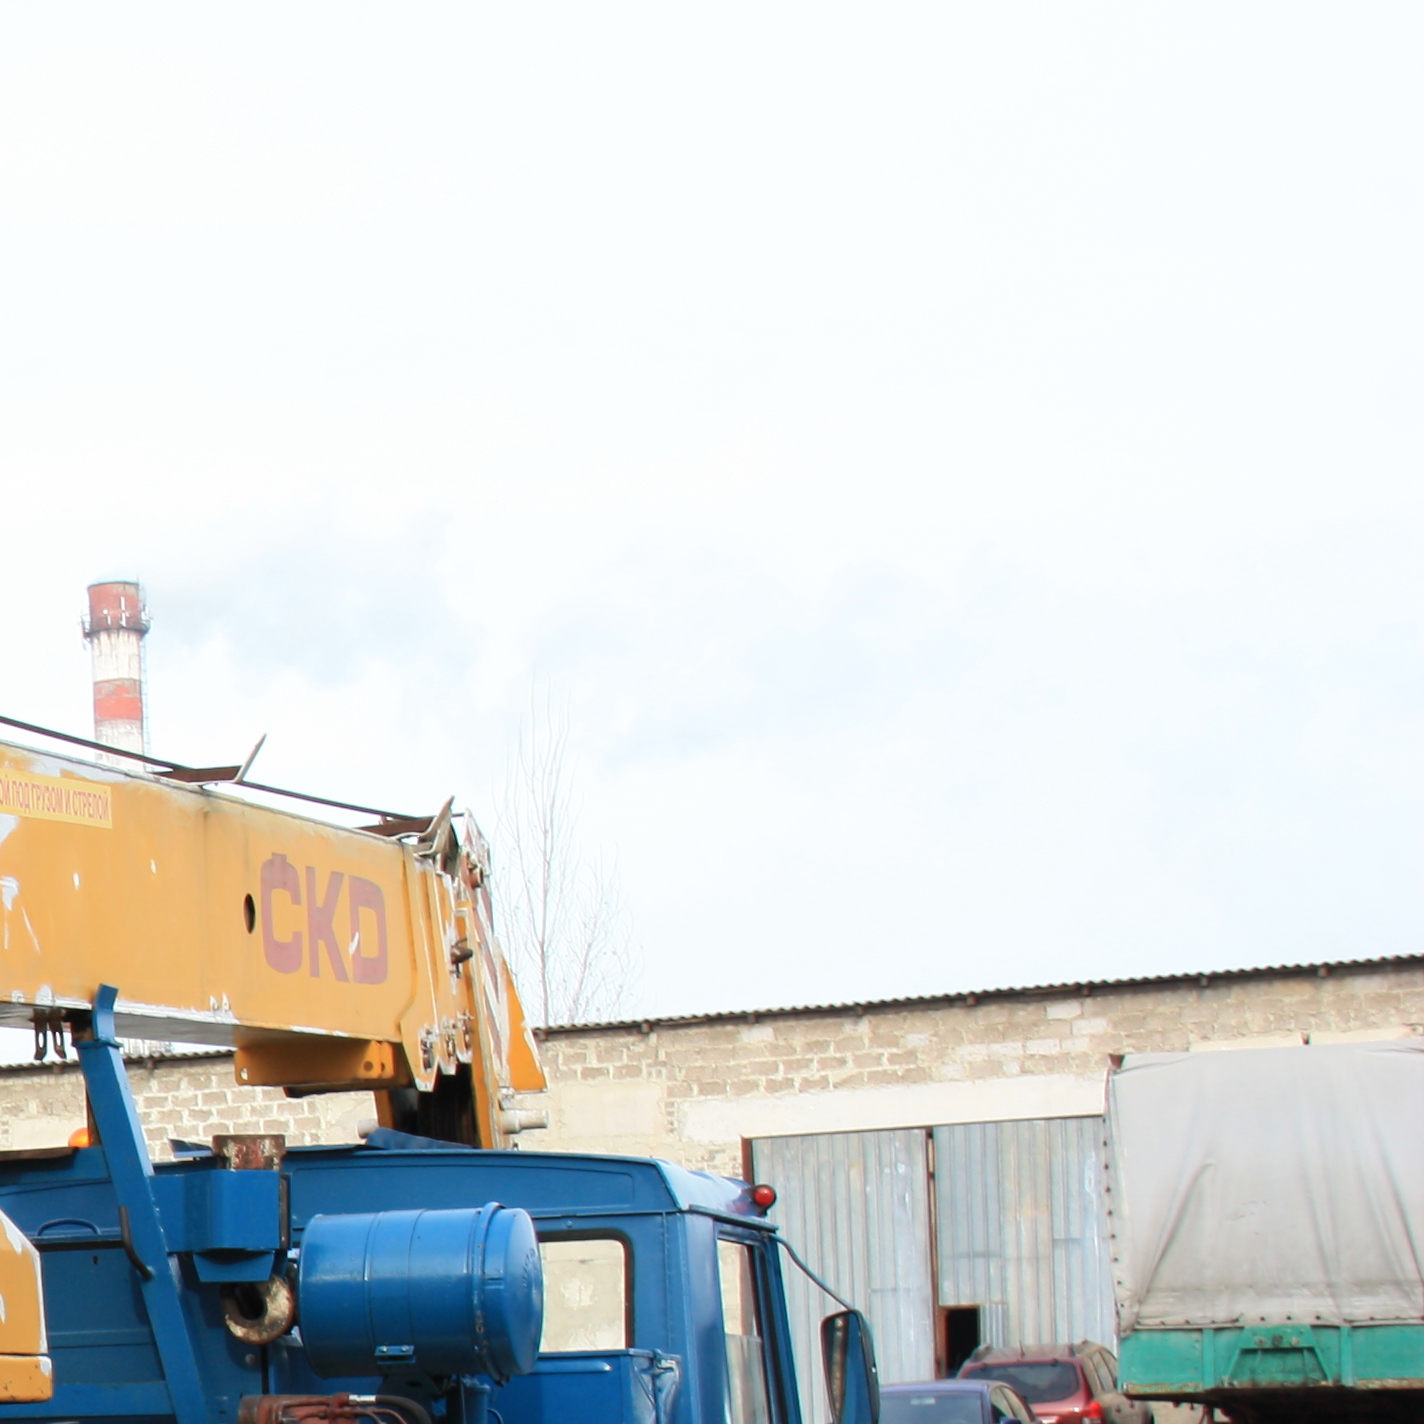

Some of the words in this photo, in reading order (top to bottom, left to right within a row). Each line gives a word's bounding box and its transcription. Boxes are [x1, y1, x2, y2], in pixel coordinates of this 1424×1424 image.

[12, 780, 31, 814] ПОД
[32, 783, 64, 815] ГРУЗОМ
[72, 790, 110, 821] СТРЕЛОЙ
